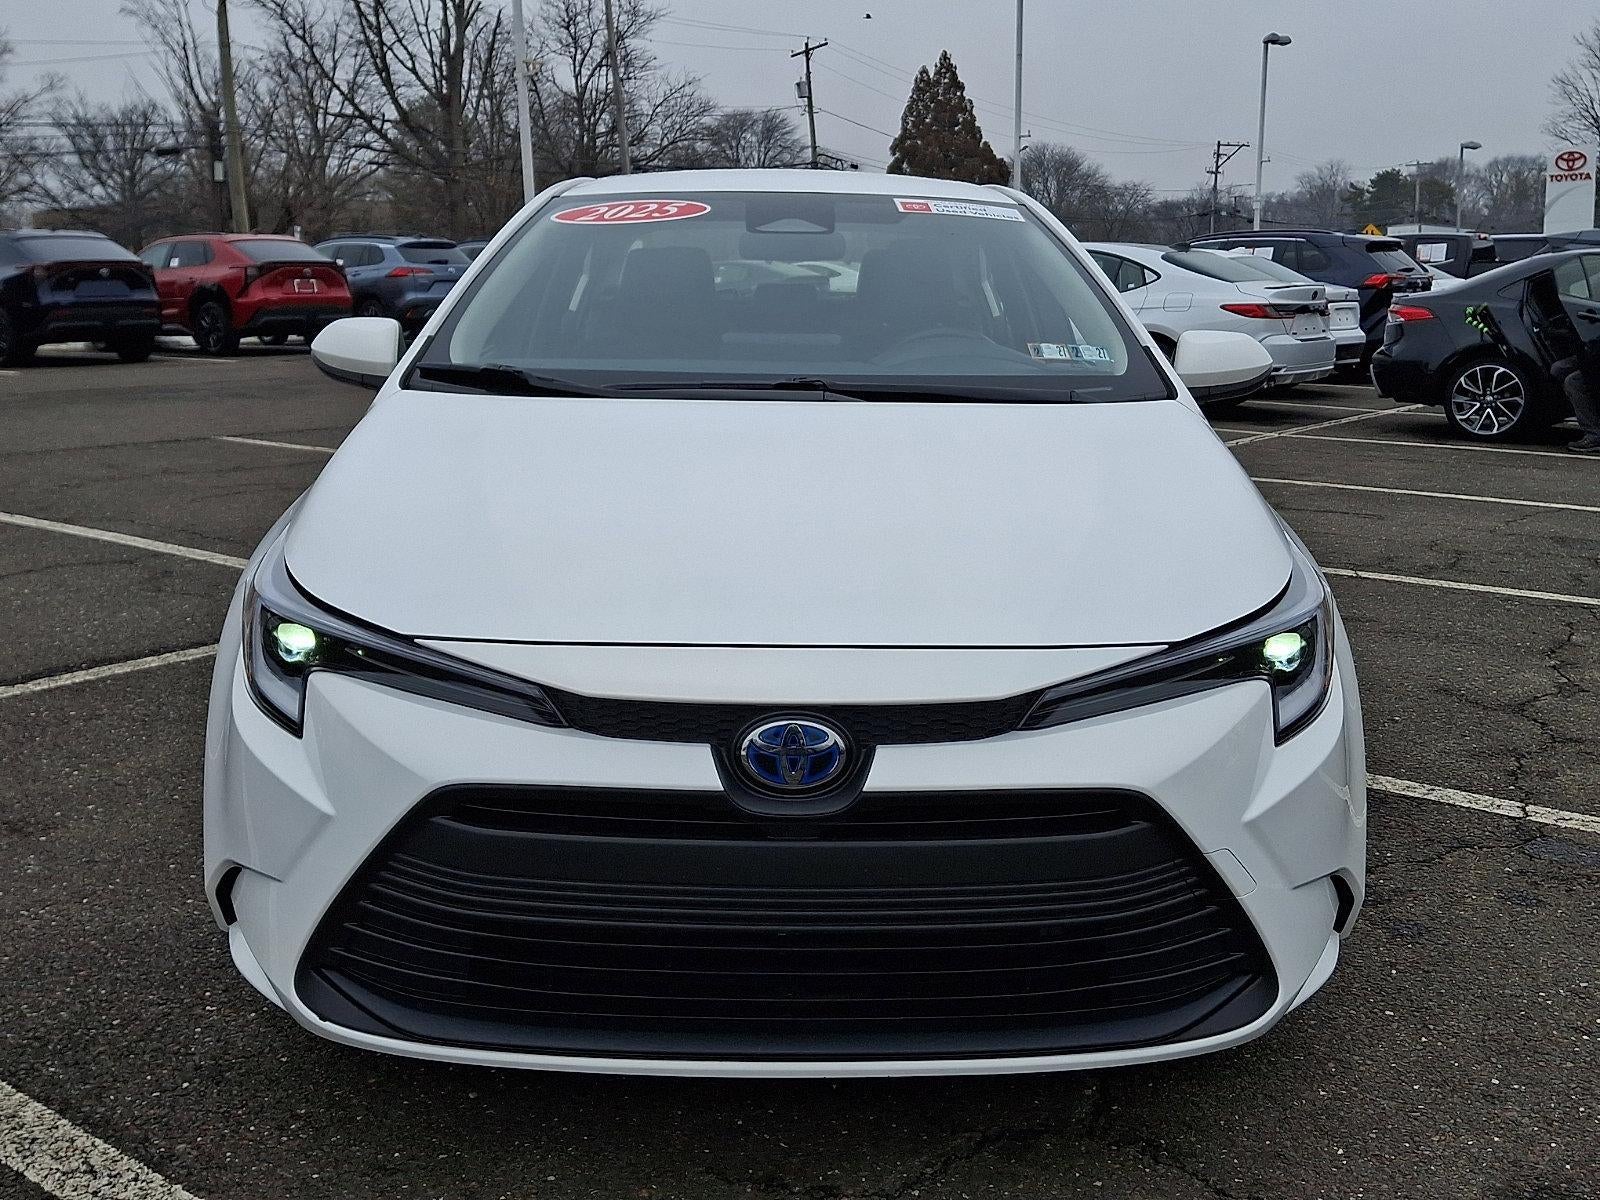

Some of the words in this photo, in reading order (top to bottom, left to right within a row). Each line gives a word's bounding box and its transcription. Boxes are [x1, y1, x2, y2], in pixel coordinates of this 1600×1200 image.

[1550, 172, 1592, 182] TOYOTA
[575, 201, 688, 221] 2025
[933, 202, 988, 213] Certified
[935, 207, 968, 215] Used
[969, 210, 1020, 220] Vehicles
[1055, 345, 1067, 358] 27
[1096, 347, 1107, 359] 27
